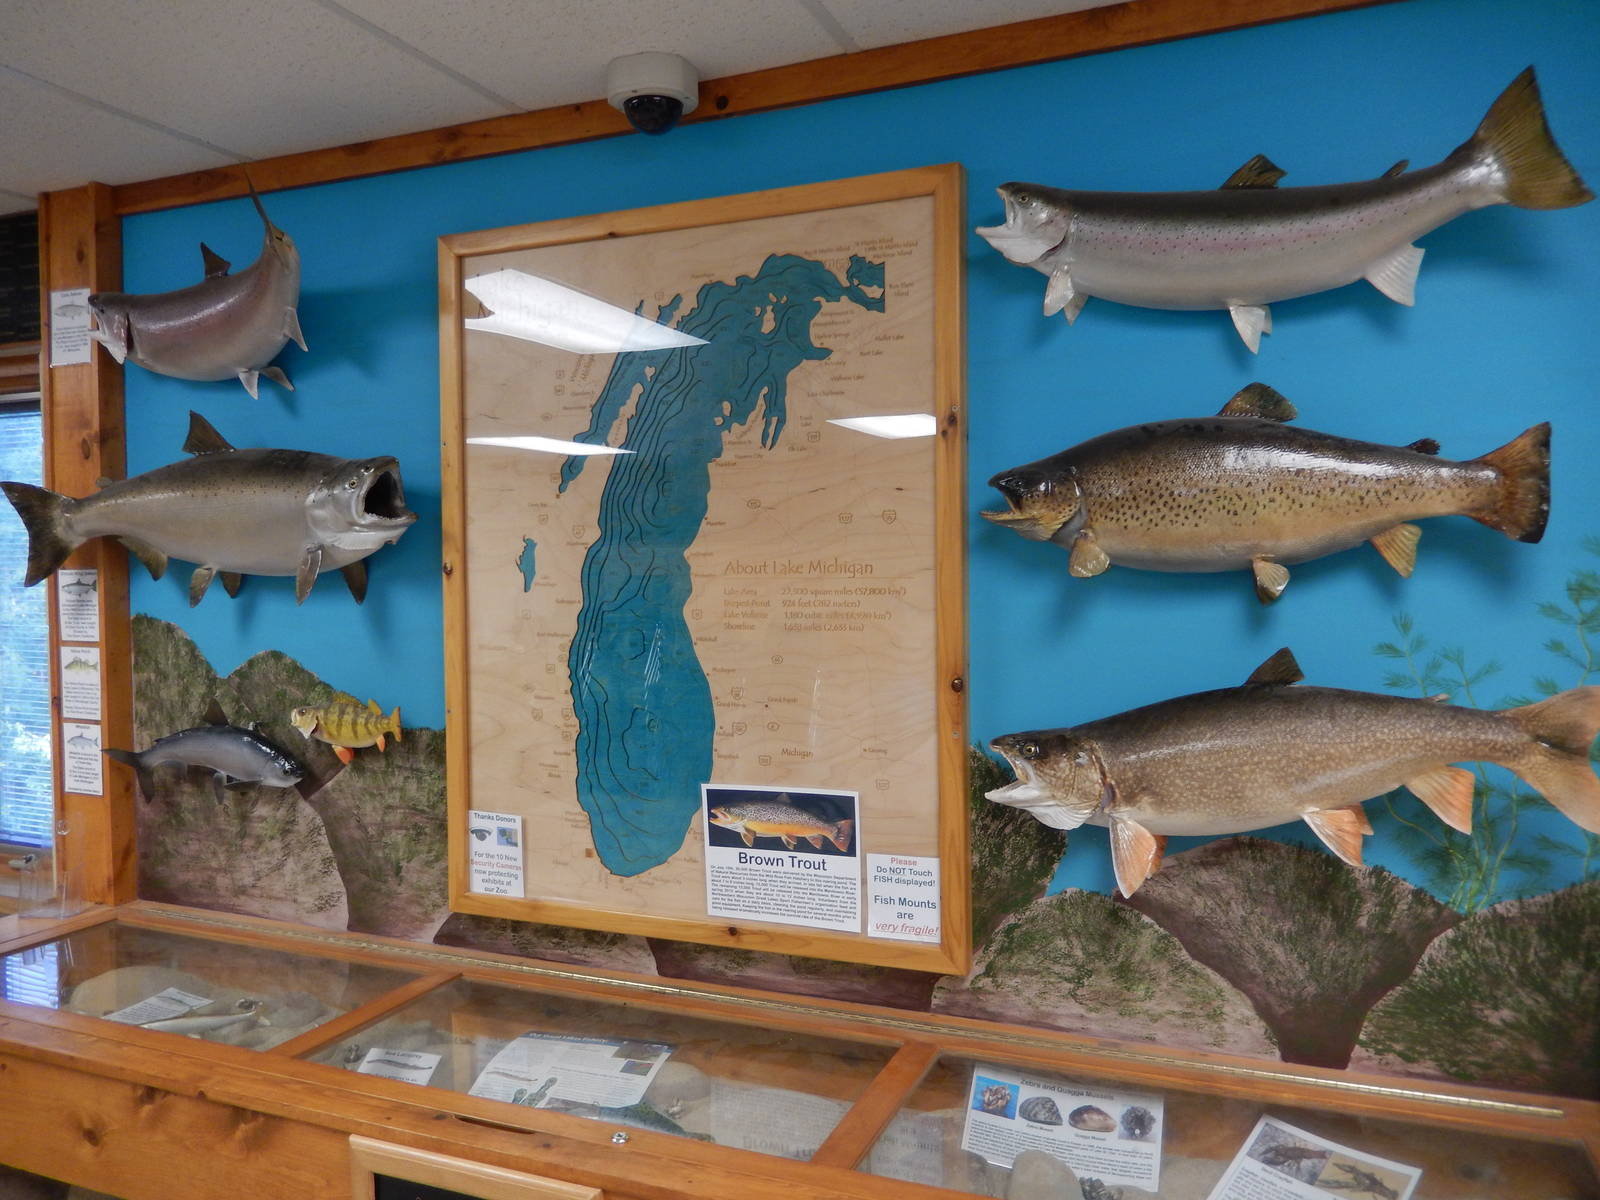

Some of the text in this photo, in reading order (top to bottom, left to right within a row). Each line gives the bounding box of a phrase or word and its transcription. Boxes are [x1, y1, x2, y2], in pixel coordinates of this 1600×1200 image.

[724, 558, 873, 578] About Lake Michigan
[474, 813, 516, 823] Thanks Donors
[471, 859, 521, 871] Security Cameras
[738, 852, 827, 871] Brown Trout
[890, 857, 917, 866] Please
[488, 870, 519, 880] protecting
[908, 868, 932, 877] Touch
[482, 878, 504, 886] exhibits
[874, 875, 936, 887] FISH displayed!
[496, 886, 508, 894] Zoo
[874, 895, 937, 909] Fish Mounts
[897, 912, 914, 920] are
[875, 923, 939, 936] very fragile!
[1021, 1079, 1114, 1100] Zebra and Quagga Mussels
